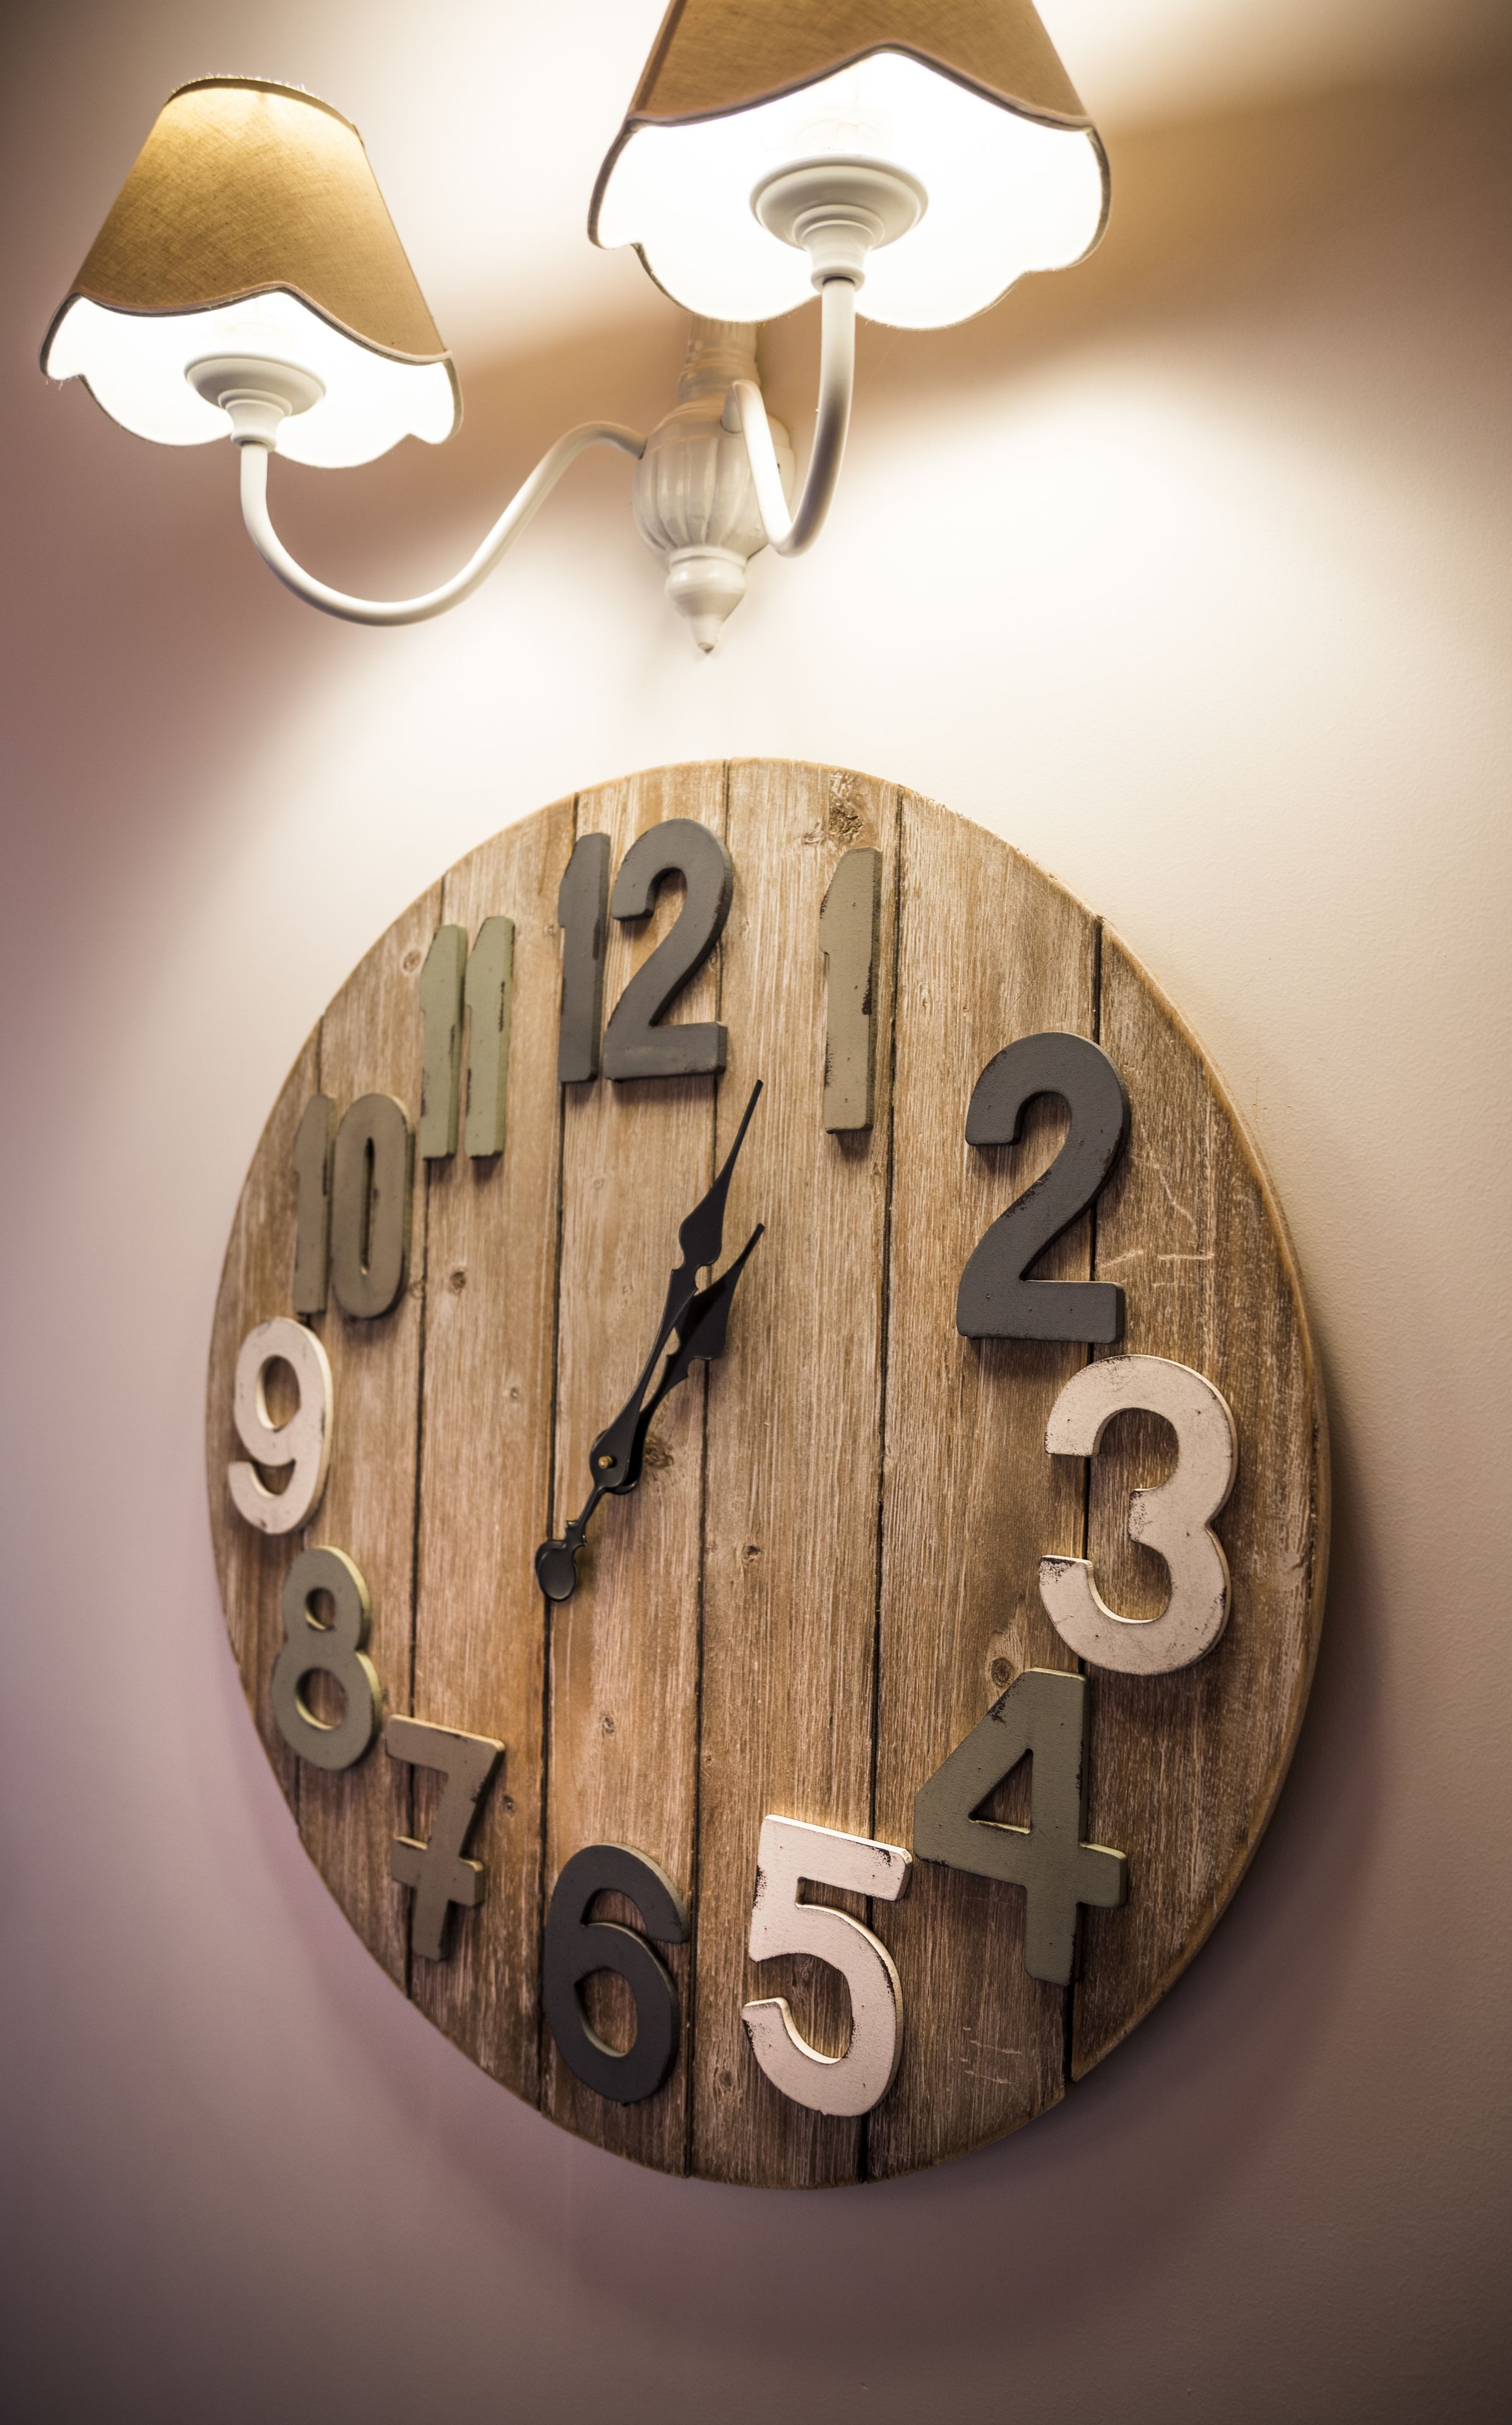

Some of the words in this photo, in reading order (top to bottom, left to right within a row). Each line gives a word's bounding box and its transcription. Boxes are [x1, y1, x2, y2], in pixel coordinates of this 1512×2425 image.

[421, 918, 514, 1159] 11
[557, 819, 734, 1085] 12
[820, 847, 883, 1134] 1
[293, 1094, 414, 1319] 10
[958, 1033, 1131, 1343] 2
[228, 1317, 334, 1535] 9
[1039, 1356, 1238, 1675] 3
[272, 1547, 379, 1771] 8
[387, 1716, 506, 1959] 7
[915, 1668, 1128, 1984] 4
[544, 1843, 690, 2104] 6
[743, 1814, 913, 2118] 5
